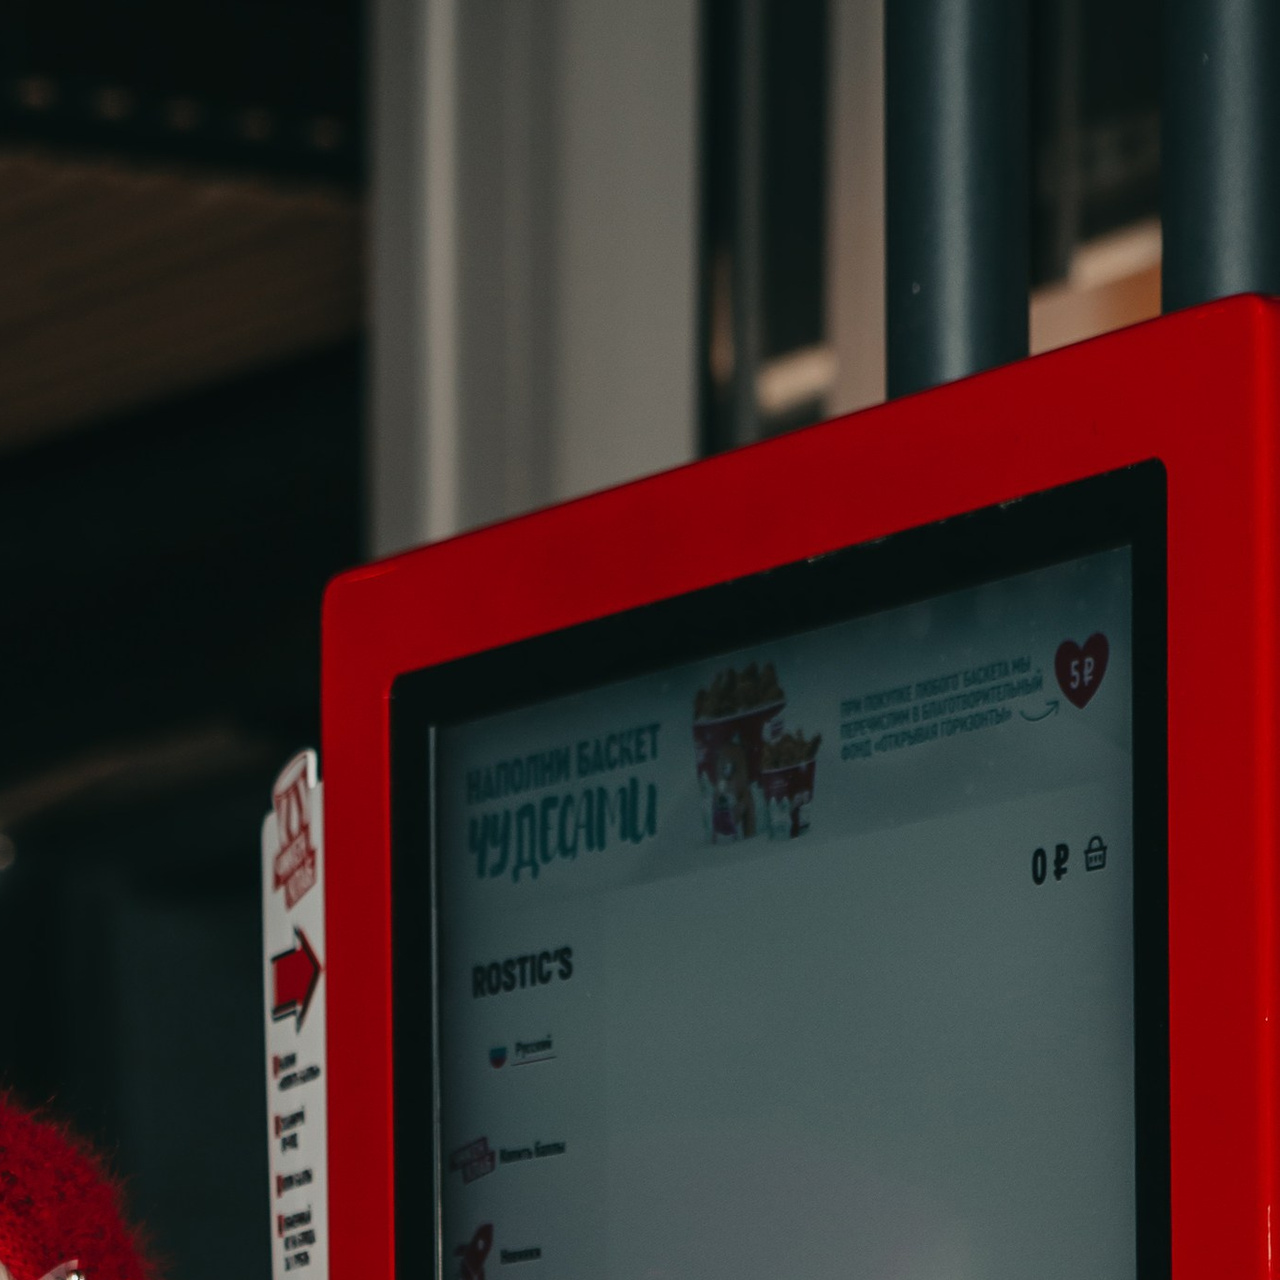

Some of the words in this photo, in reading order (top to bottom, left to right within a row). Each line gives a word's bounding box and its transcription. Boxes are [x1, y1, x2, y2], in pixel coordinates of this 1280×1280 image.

[468, 745, 571, 805] НАПОЛНИ
[577, 723, 661, 779] БАСКЕТ
[468, 776, 658, 883] ЧУДЕСАМИ
